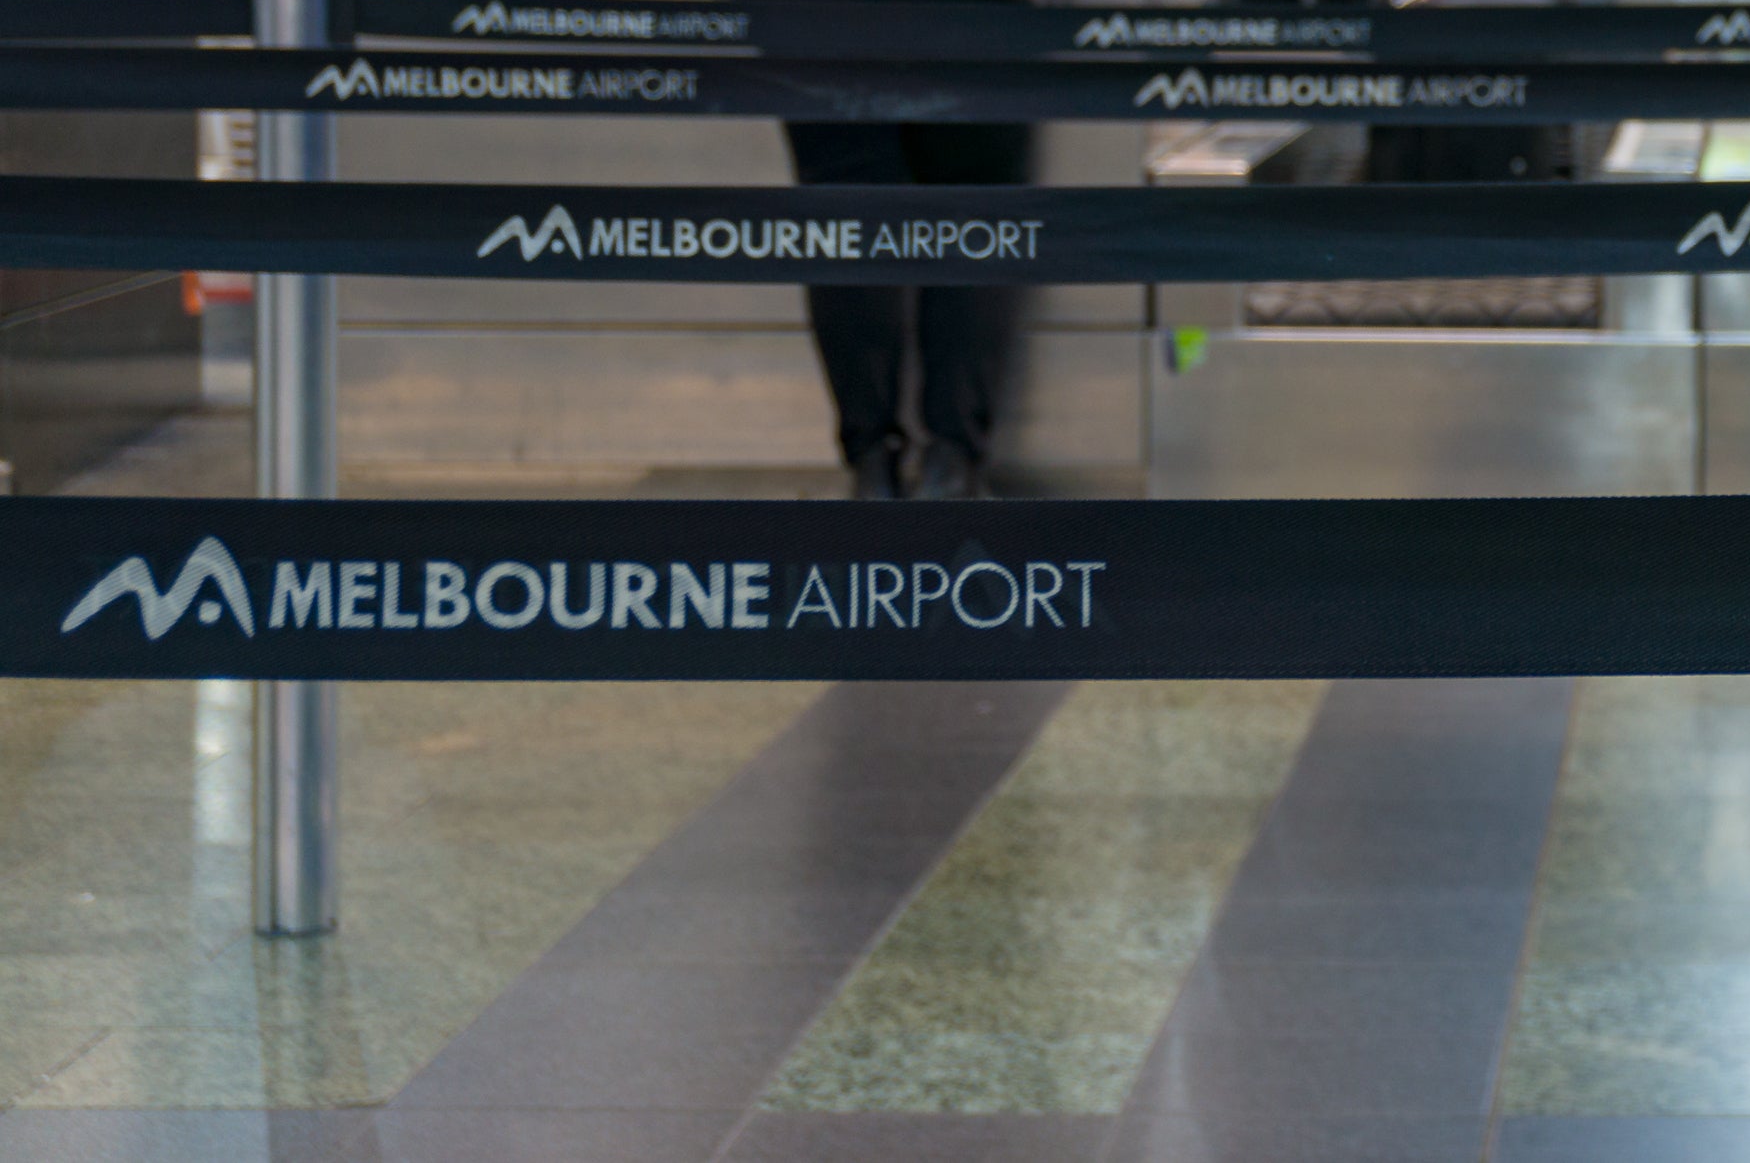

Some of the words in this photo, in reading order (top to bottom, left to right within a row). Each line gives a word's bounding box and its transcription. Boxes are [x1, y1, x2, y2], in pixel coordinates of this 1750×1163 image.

[509, 9, 655, 39] MELBOURNE
[658, 13, 748, 40] AIRPORT
[1133, 17, 1277, 45] MELBOURNE
[1279, 18, 1371, 45] AIRPORT
[385, 69, 573, 100] MELBOURNE
[578, 70, 698, 101] AIRPORT
[1214, 76, 1403, 108] MELBOURNE
[1407, 77, 1527, 108] AIRPORT
[590, 219, 863, 260] MELBOURNE
[870, 220, 1044, 260] AIRPORT
[269, 560, 771, 631] MELBOURNE
[787, 562, 1107, 629] AIRPORT
